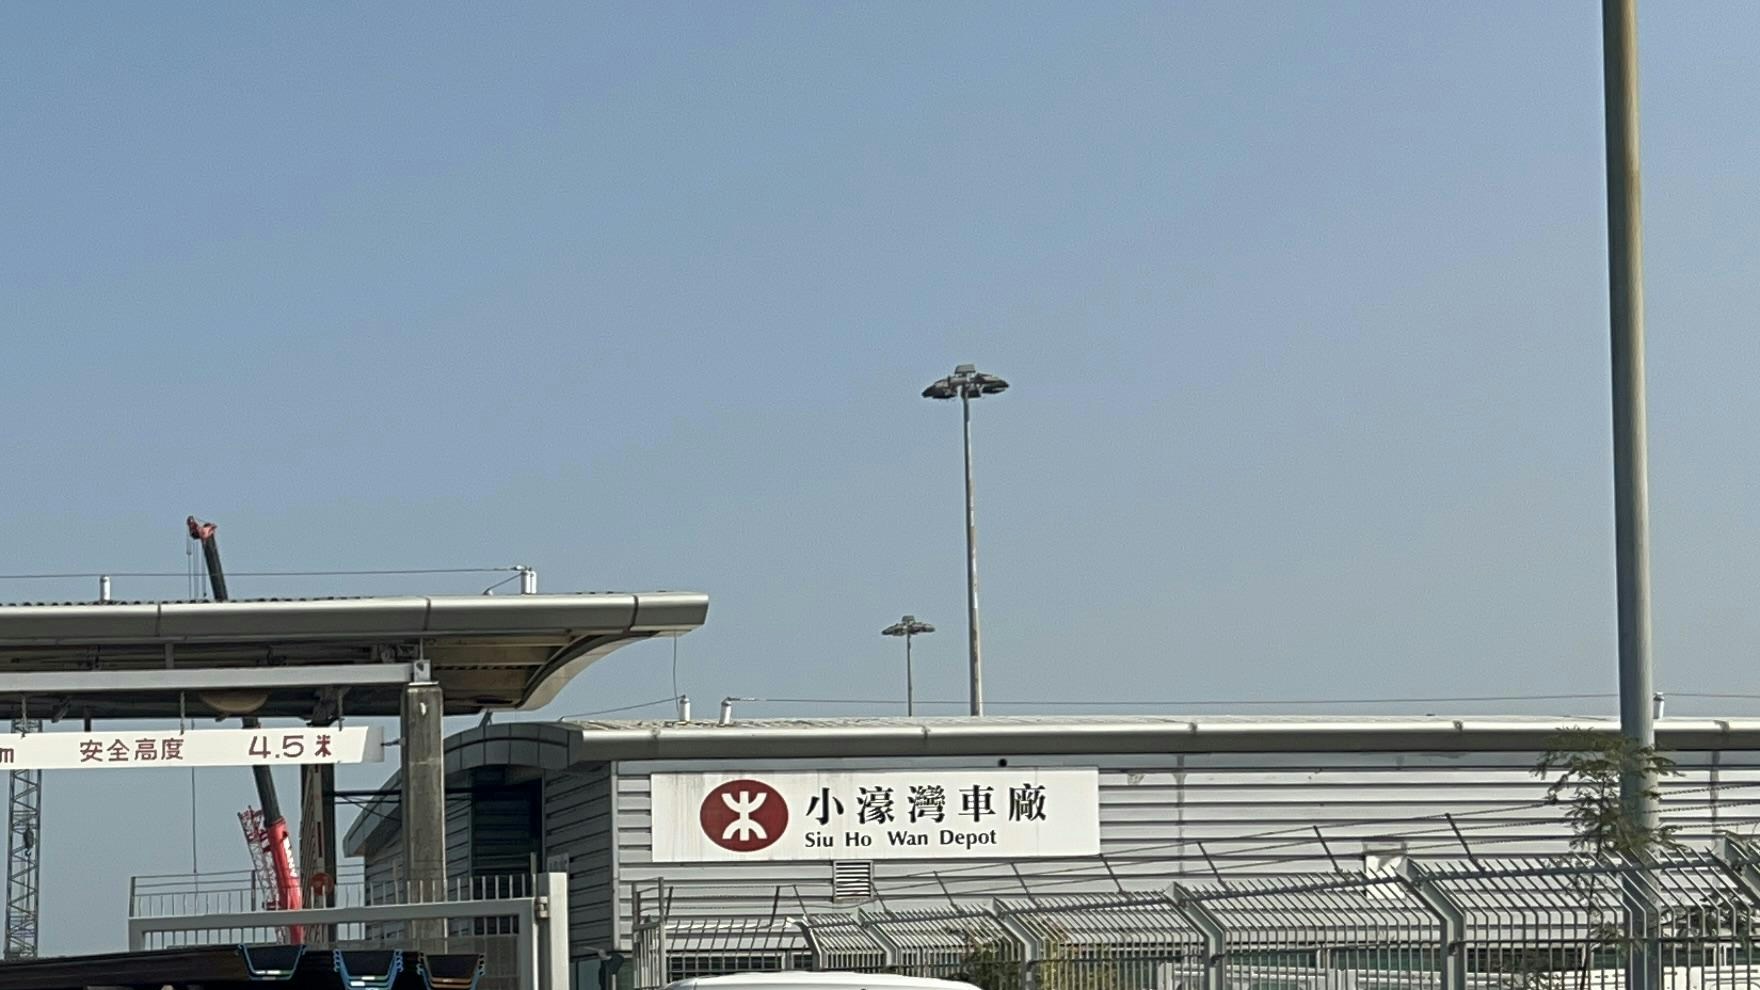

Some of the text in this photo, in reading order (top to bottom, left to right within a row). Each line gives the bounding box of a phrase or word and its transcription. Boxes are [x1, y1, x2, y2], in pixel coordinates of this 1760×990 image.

[79, 738, 184, 762] 安全高度
[806, 783, 1046, 825] 小濠灣車廠
[805, 829, 997, 849] Siu Ho Wan Depot
